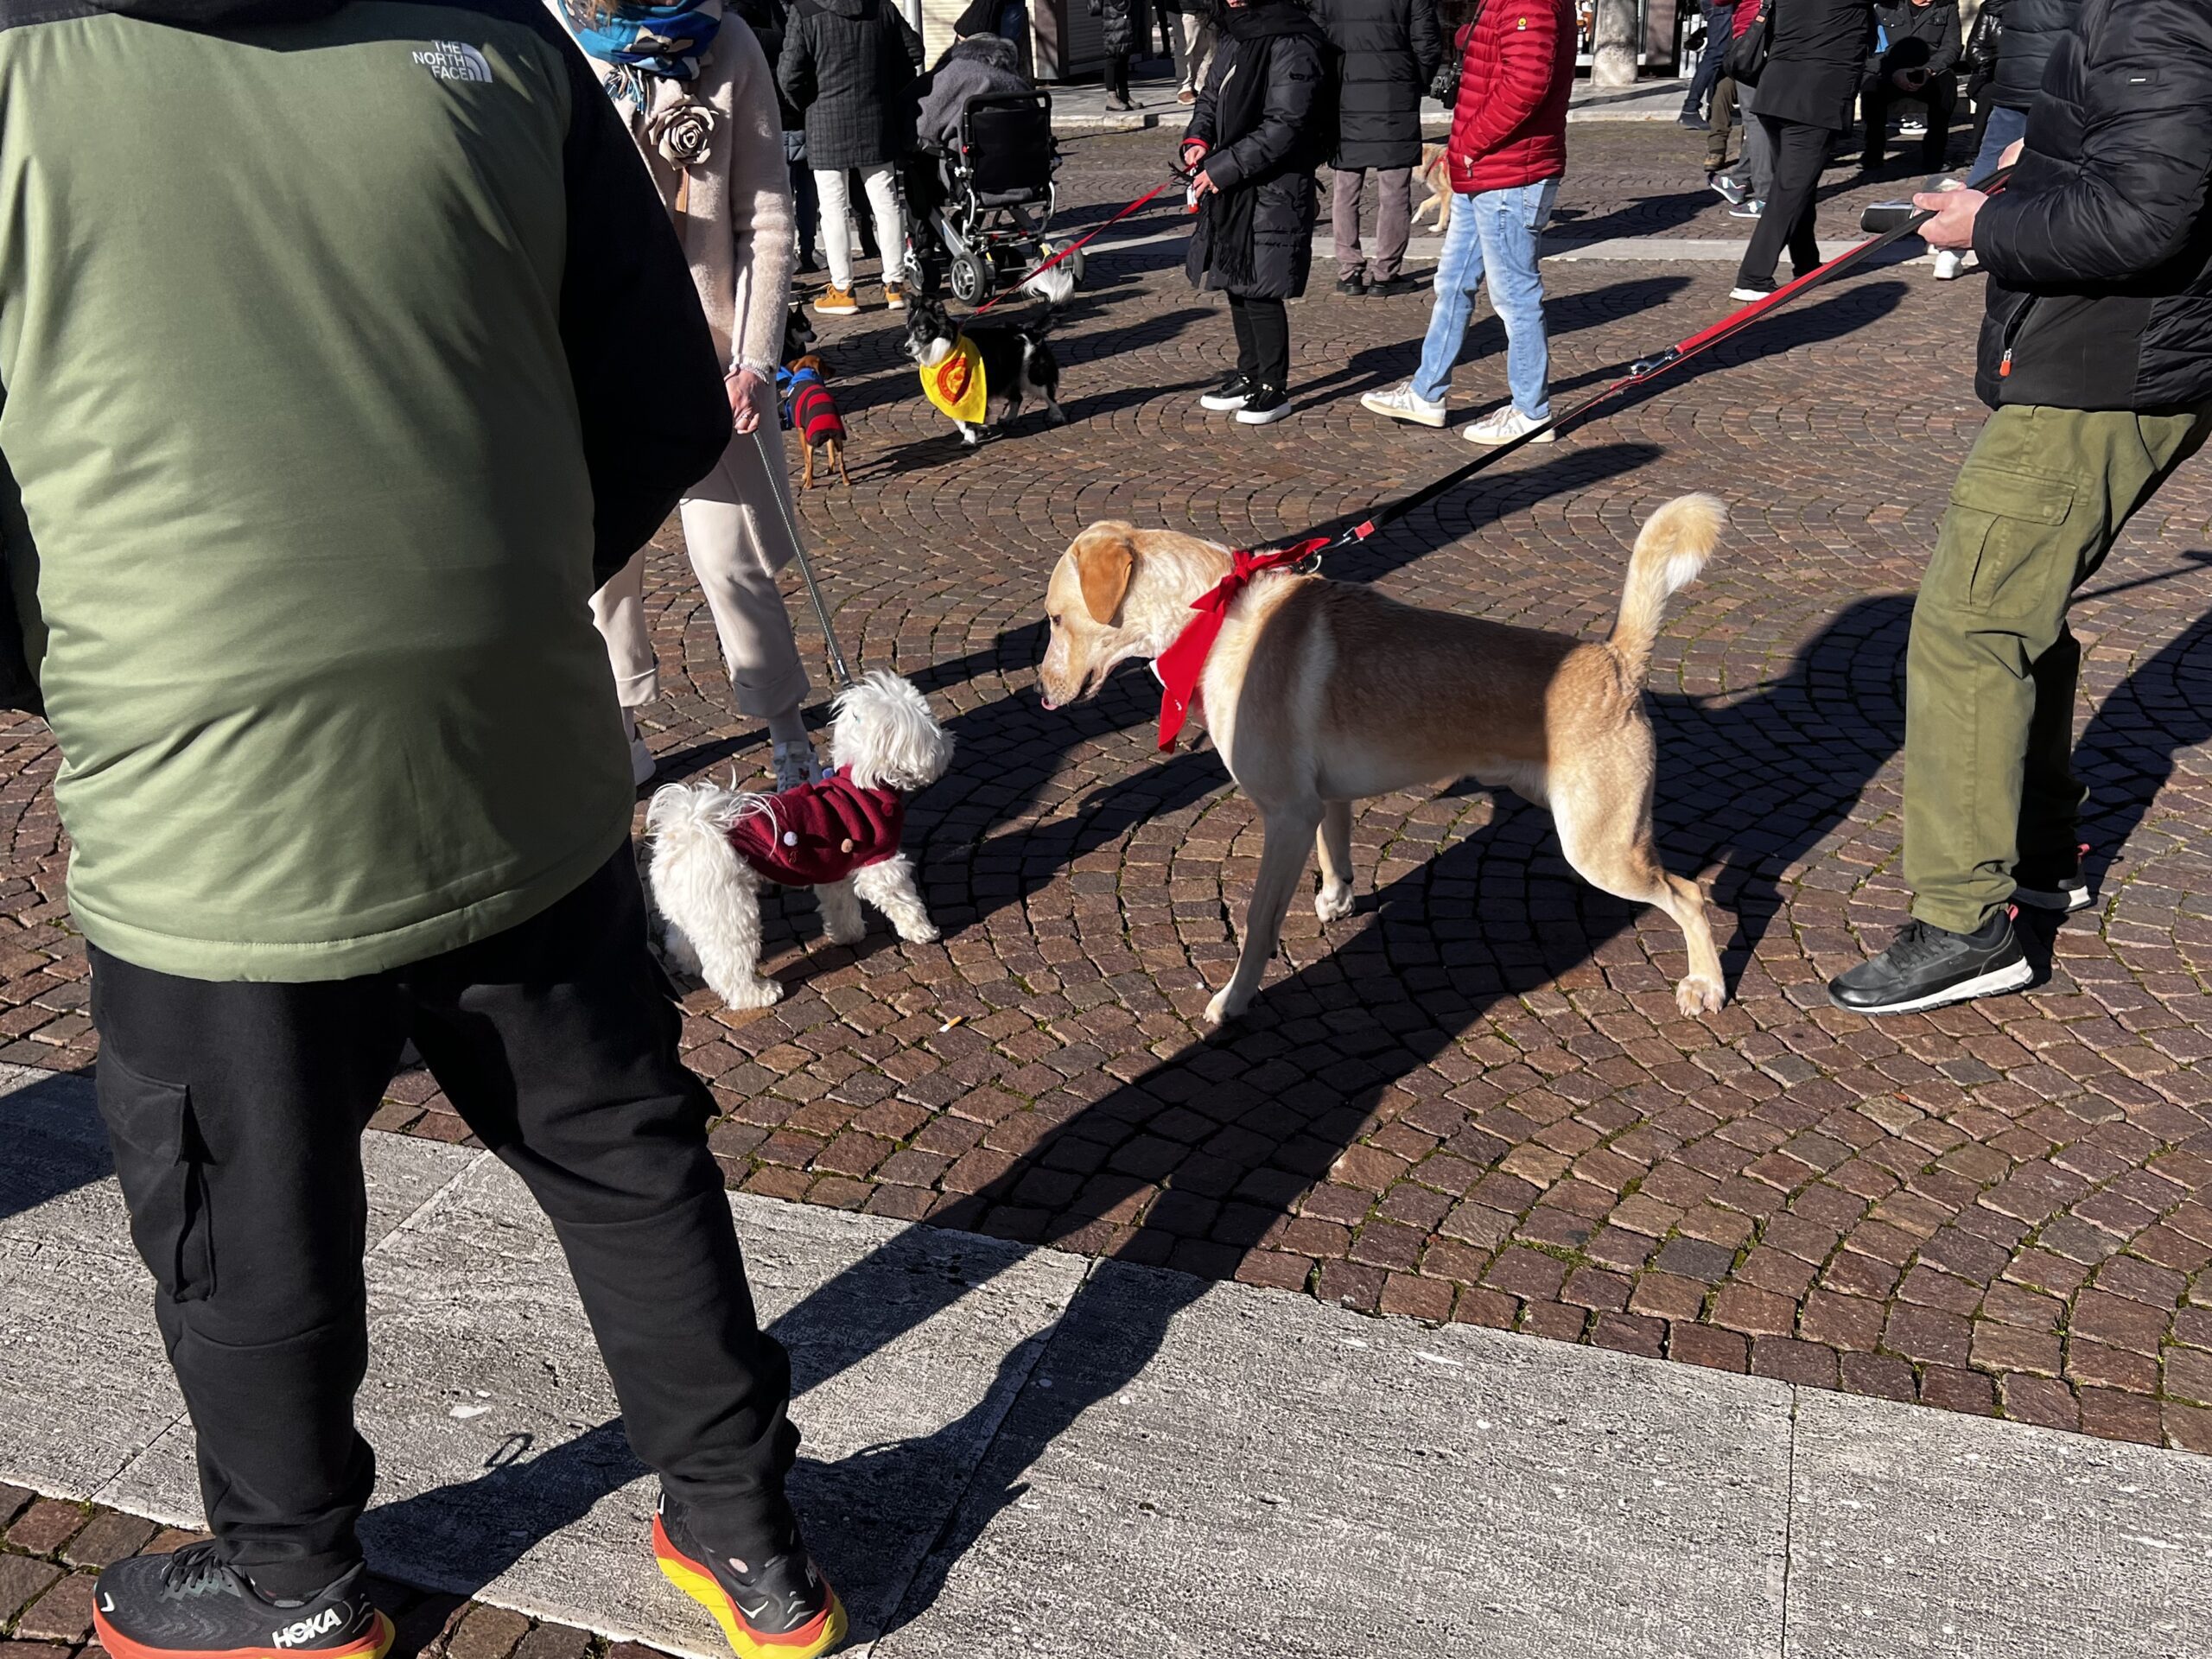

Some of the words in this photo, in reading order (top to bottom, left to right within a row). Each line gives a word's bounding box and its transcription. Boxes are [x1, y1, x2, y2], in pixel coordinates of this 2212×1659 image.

[431, 40, 461, 54] THE
[412, 51, 467, 67] NORTH
[431, 65, 469, 81] FACE
[272, 1608, 342, 1649] HOKA
